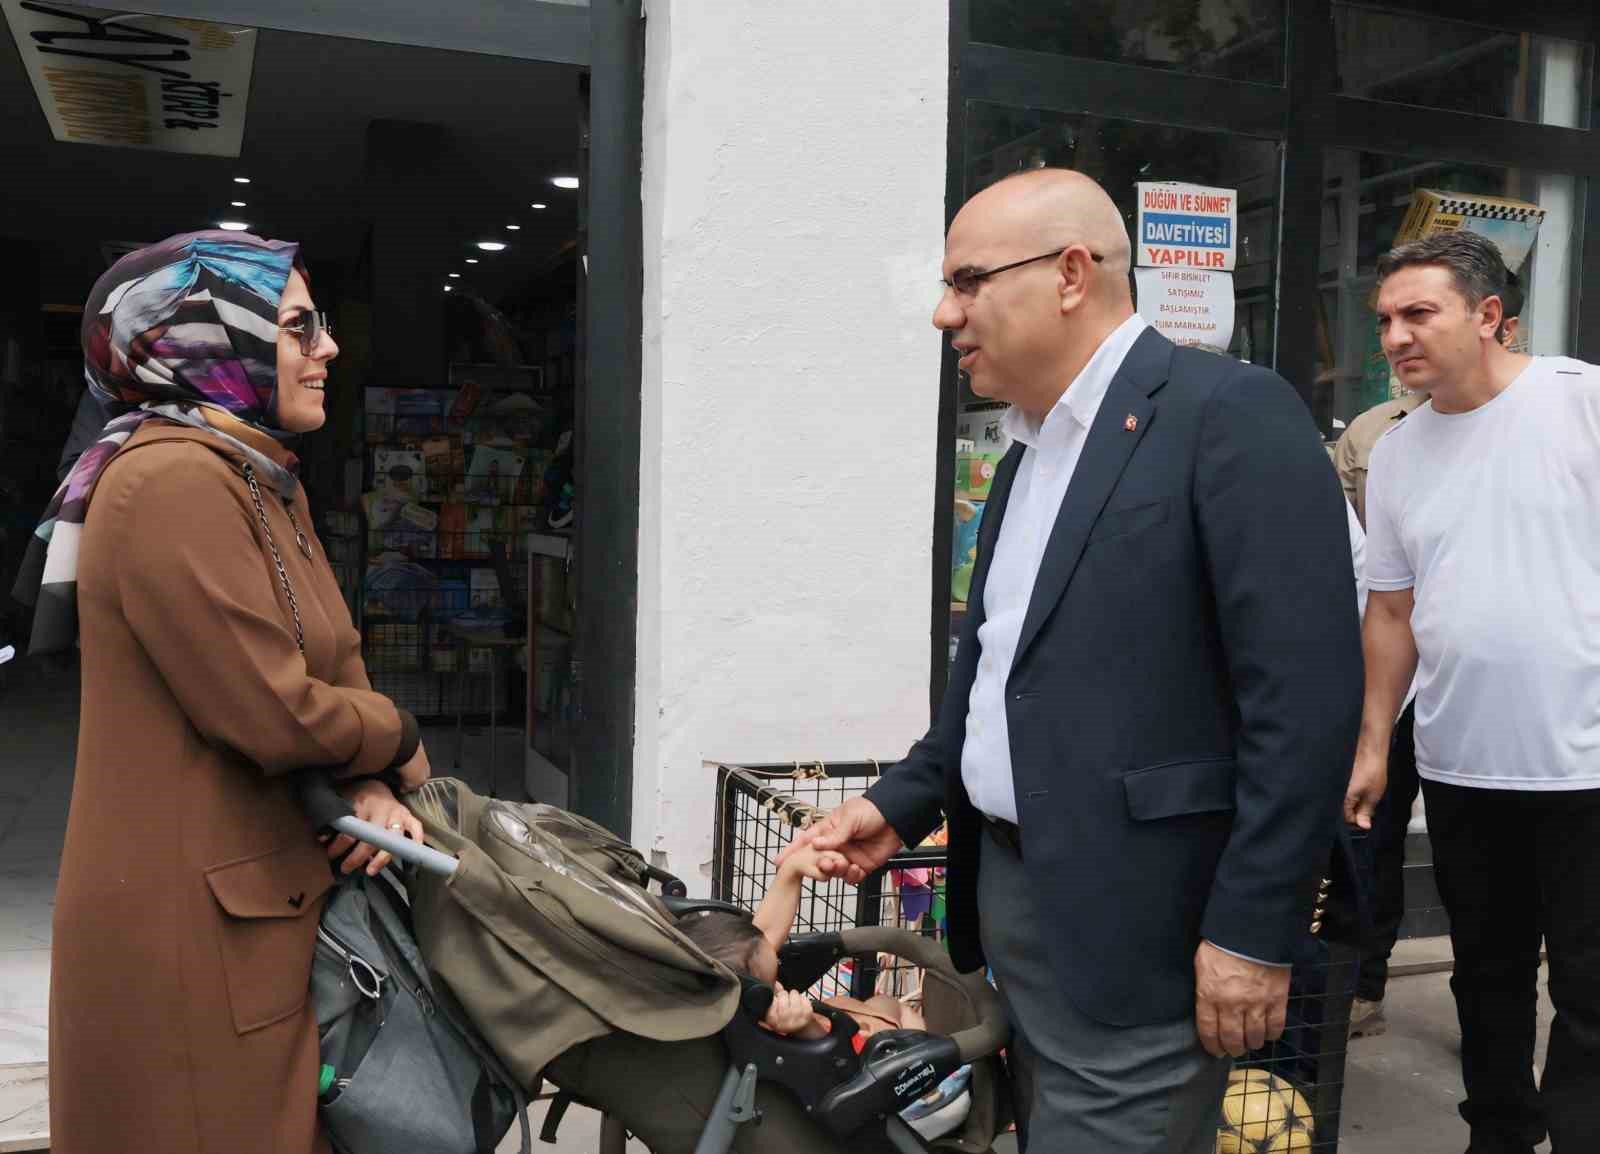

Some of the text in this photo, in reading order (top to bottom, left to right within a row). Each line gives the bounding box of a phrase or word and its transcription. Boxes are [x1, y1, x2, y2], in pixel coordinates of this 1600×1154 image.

[1144, 188, 1231, 214] DÜĞÜN VE SÜNNET
[1146, 220, 1227, 245] DAVETİYESİ
[1148, 248, 1225, 268] YAPILIR
